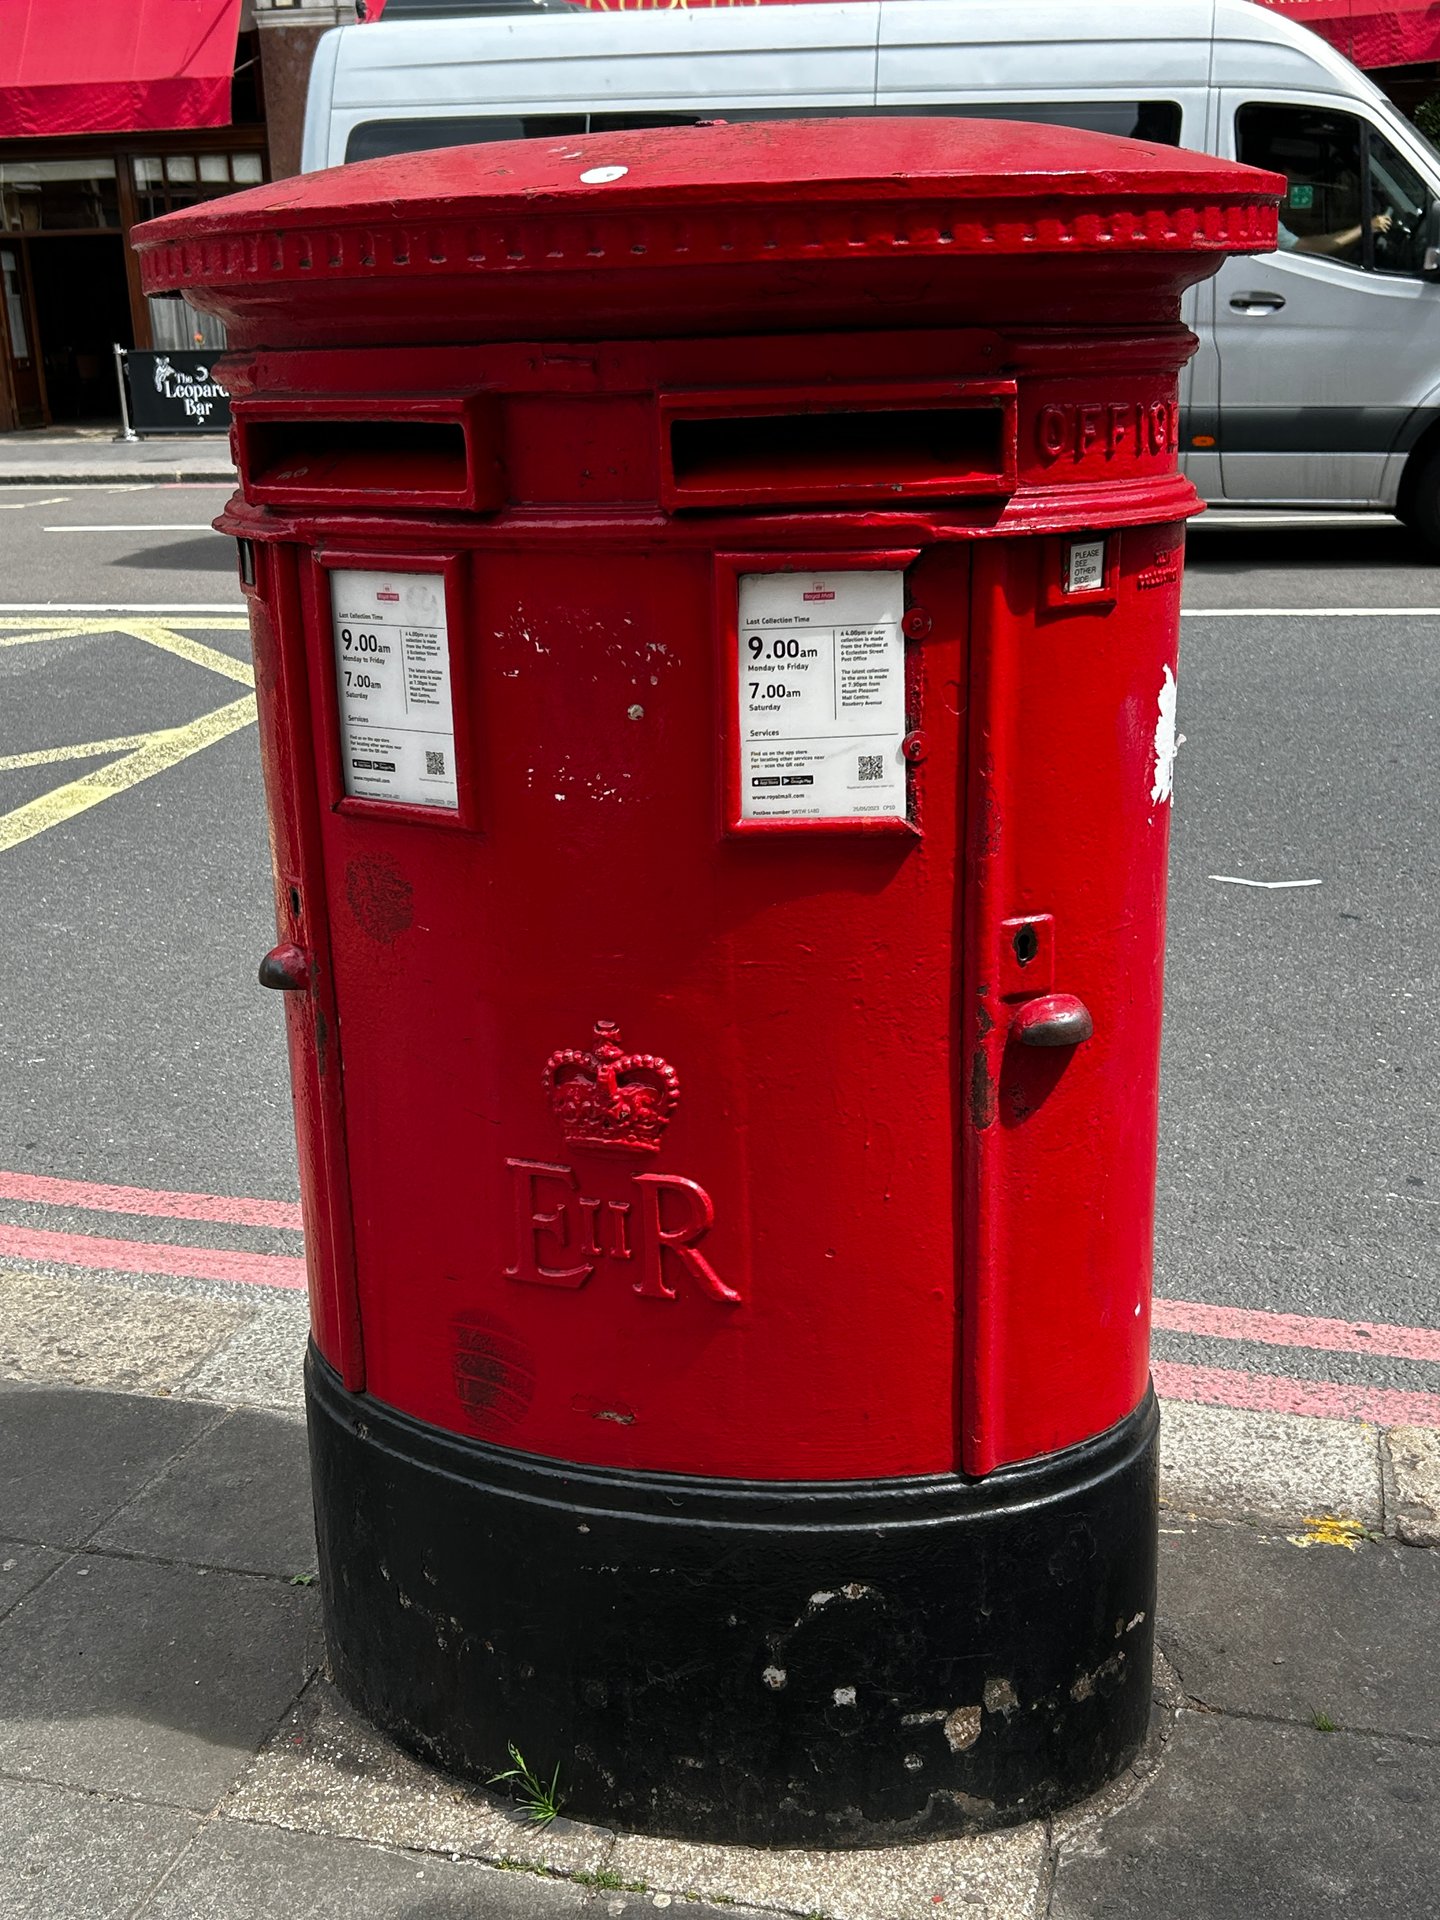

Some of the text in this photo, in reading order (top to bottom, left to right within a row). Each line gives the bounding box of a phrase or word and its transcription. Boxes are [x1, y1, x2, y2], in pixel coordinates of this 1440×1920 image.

[174, 373, 193, 383] The
[184, 399, 213, 415] Bar
[1075, 549, 1099, 559] PLEASE
[1074, 559, 1088, 568] SEE
[1074, 566, 1096, 576] OTHER
[762, 617, 792, 625] Collection
[342, 629, 391, 653] 9.00am
[748, 636, 818, 660] 9.00am
[343, 655, 361, 663] Monday
[370, 657, 385, 665] Friday
[748, 664, 775, 672] Monday
[787, 663, 809, 671] Friday
[344, 671, 382, 689] 7.00am
[346, 691, 368, 700] Saturday
[749, 682, 801, 699] 7.00am
[750, 729, 779, 737] Services
[752, 793, 805, 801] www.royalmail.com
